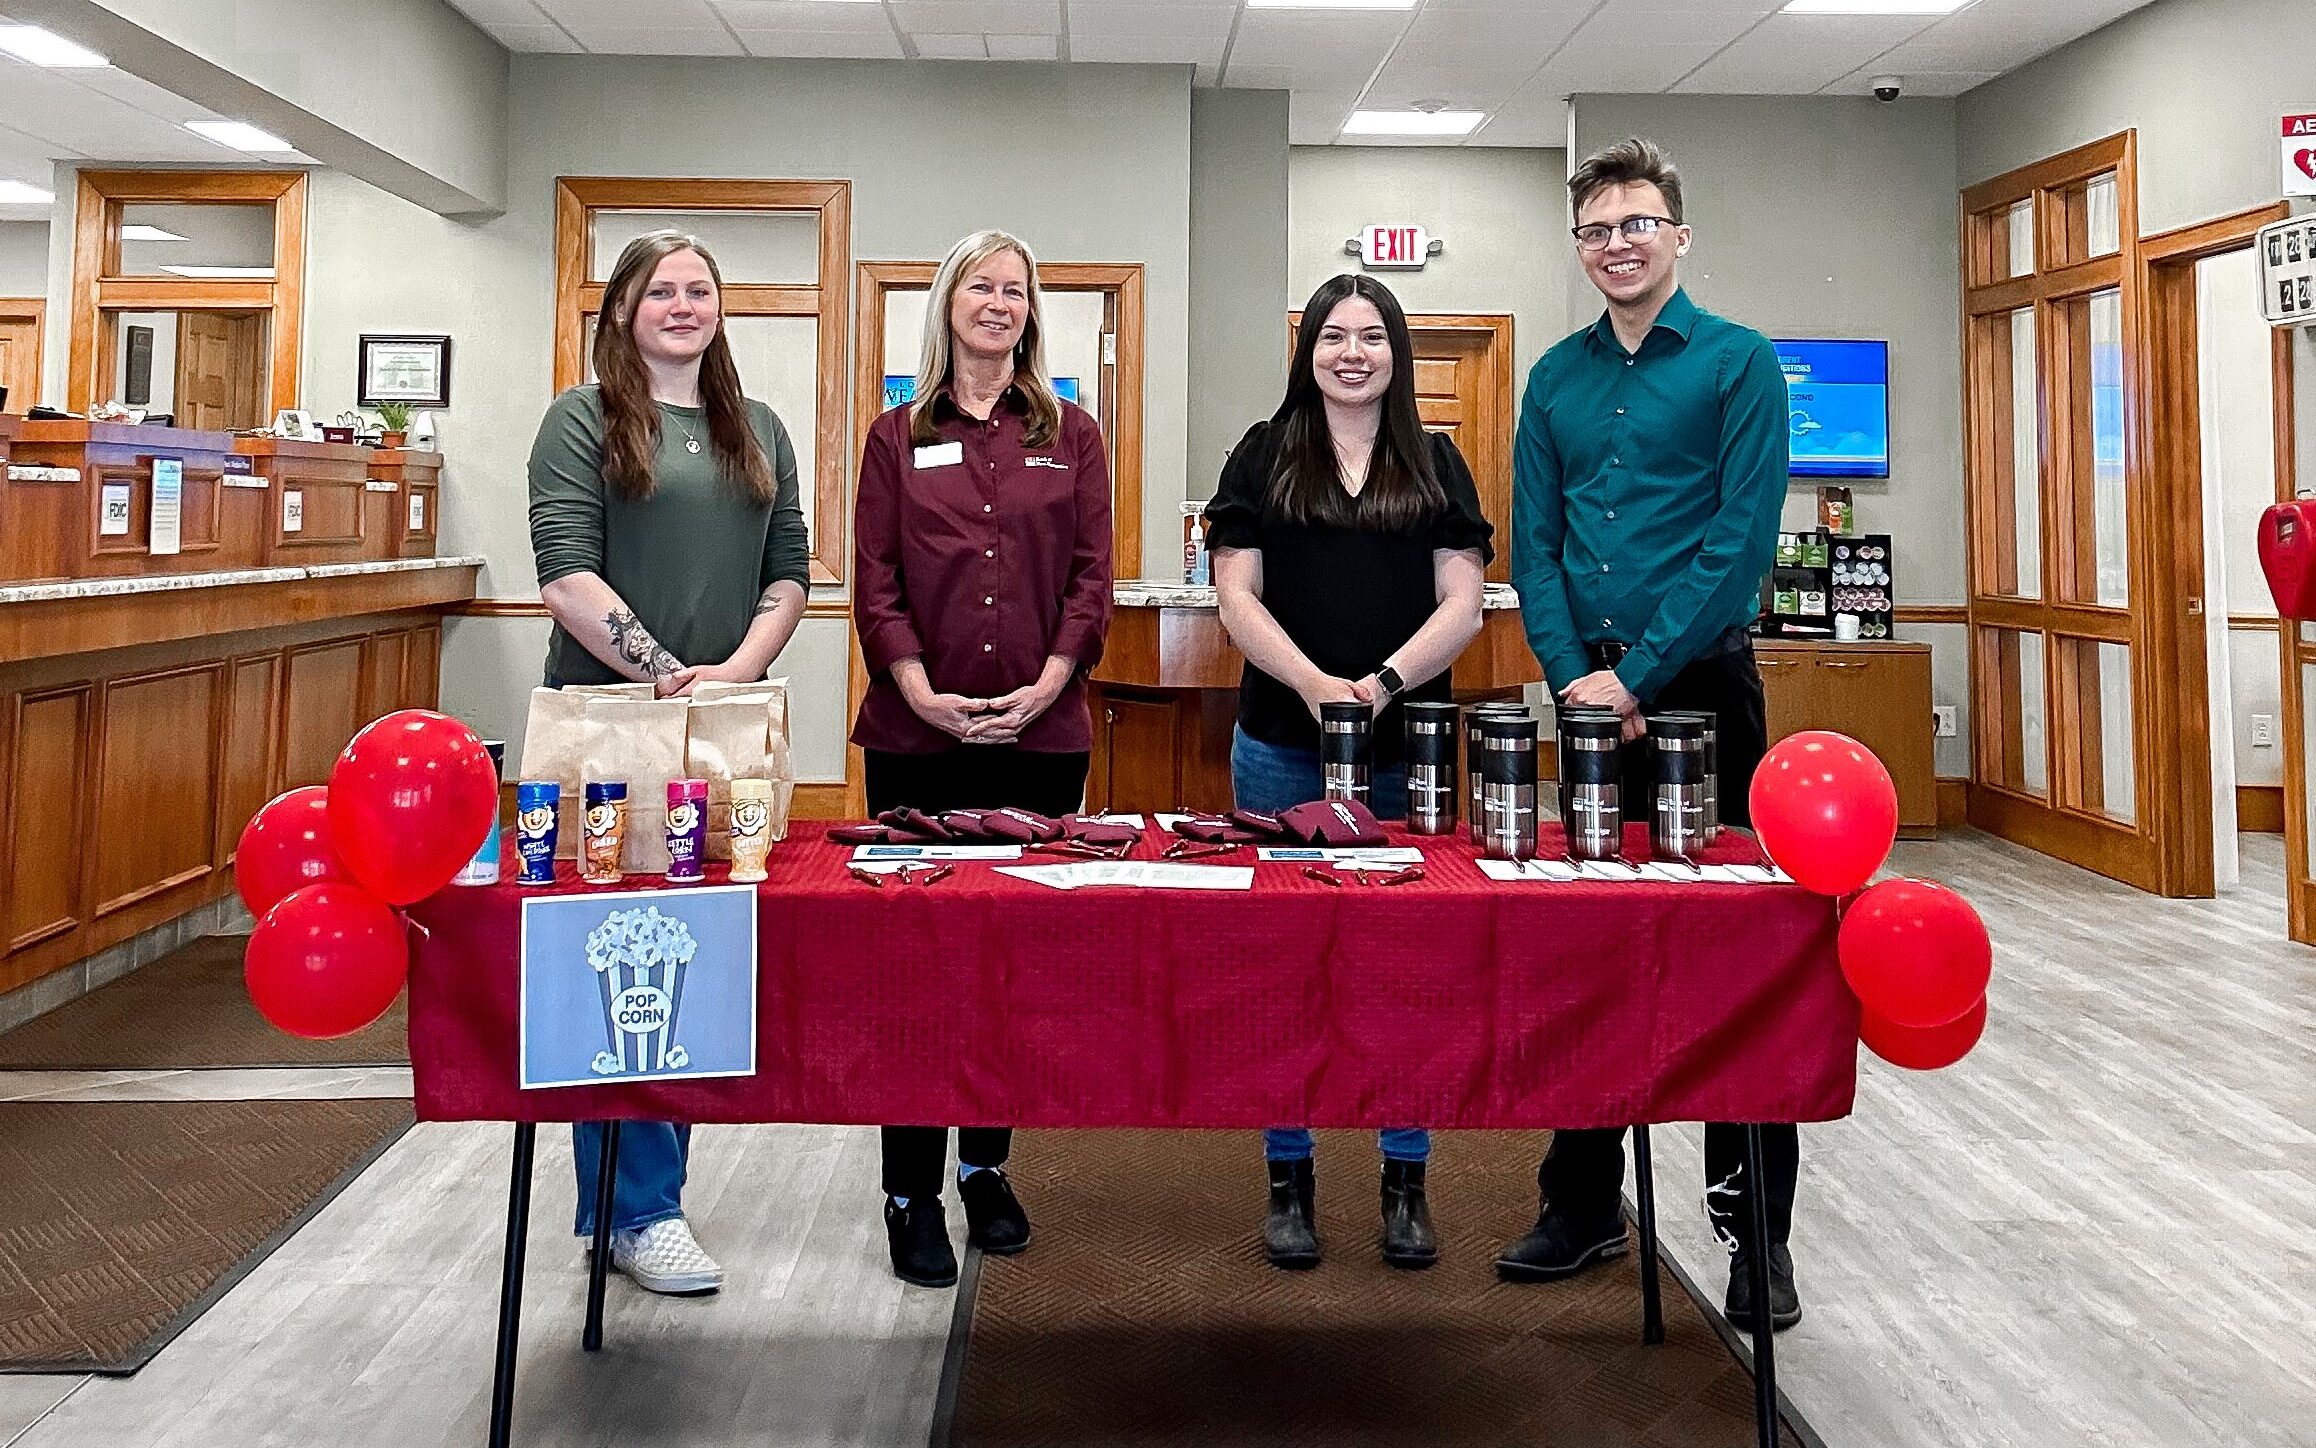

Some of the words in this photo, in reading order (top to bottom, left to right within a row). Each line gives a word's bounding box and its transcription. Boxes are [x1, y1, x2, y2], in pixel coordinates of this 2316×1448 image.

[1374, 228, 1417, 261] EXIT
[625, 994, 657, 1009] POP
[619, 1009, 664, 1024] CORN
